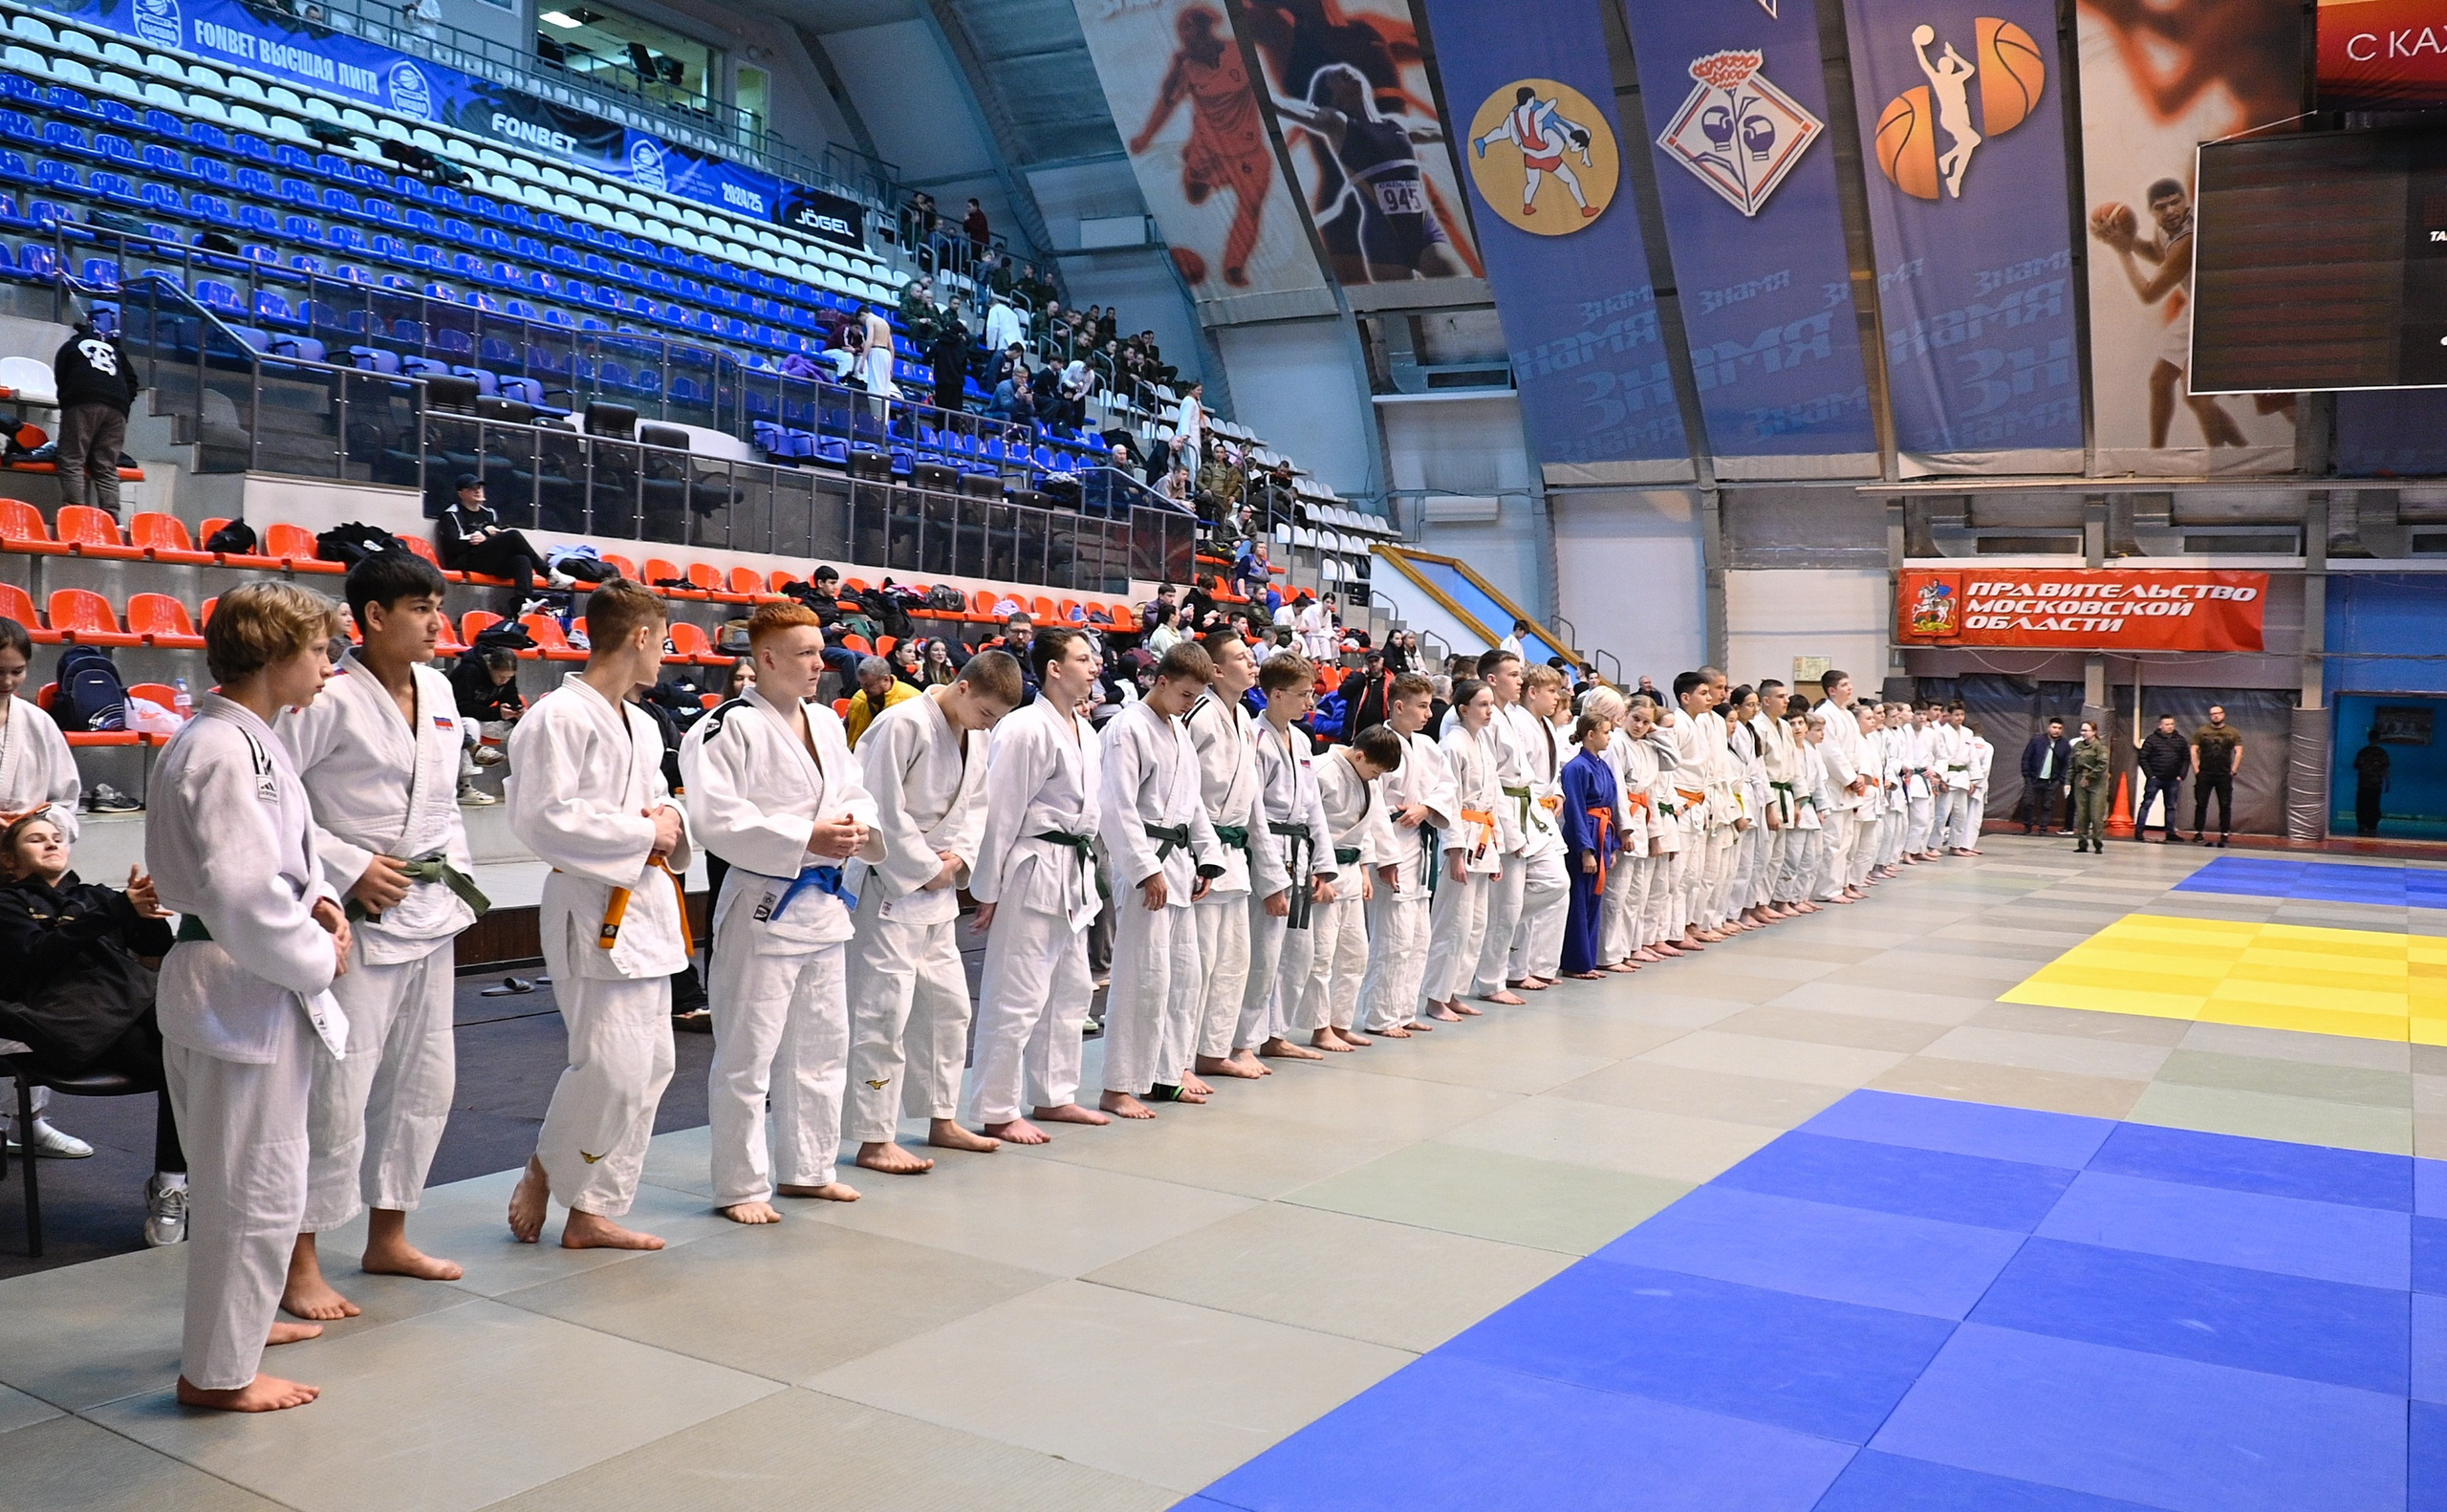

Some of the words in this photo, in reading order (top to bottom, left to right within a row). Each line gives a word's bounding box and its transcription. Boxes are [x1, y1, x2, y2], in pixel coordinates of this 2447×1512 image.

[2390, 26, 2447, 58] КА
[194, 19, 256, 60] FONBET
[259, 38, 335, 83] ВЫСШАЯ
[337, 62, 379, 96] ЛИГА
[492, 113, 577, 155] FONBET
[722, 182, 764, 213] 2024/25
[1384, 188, 1421, 211] 945
[795, 208, 855, 237] JÖGEL
[1966, 582, 2258, 601] ПРАВИТЕЛЬСТВО
[1966, 598, 2195, 616] МОСКОВСКОЙ
[1965, 616, 2125, 632] ОБЛАСТИ
